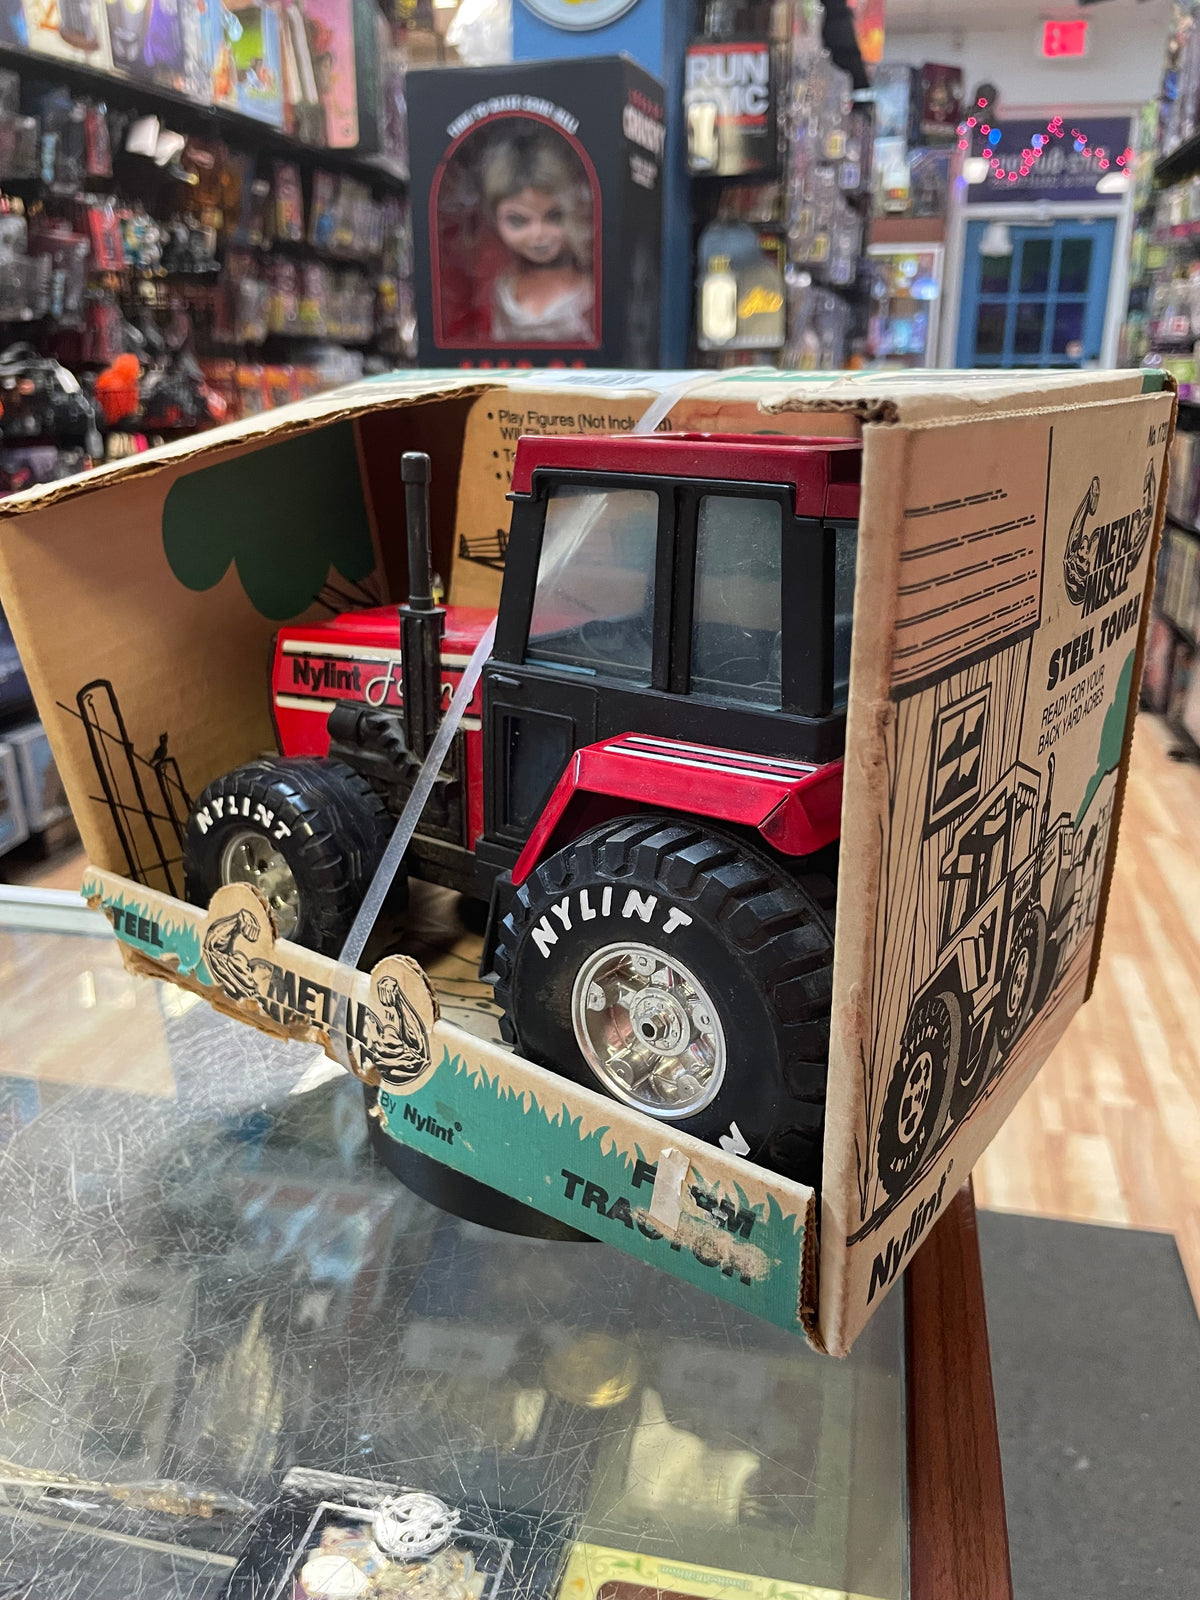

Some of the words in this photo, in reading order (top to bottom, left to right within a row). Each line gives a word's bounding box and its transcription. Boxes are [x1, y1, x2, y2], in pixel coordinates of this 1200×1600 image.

[685, 52, 770, 86] RUN
[499, 410, 524, 427] Play
[528, 411, 575, 429] Figures
[578, 414, 606, 431] (Not
[609, 416, 672, 432] Includ)
[1093, 509, 1141, 571] METAL
[1081, 550, 1138, 619] MUSCLE
[1047, 627, 1095, 691] STEEL
[1099, 592, 1141, 654] TOUGH
[293, 656, 361, 692] Nylint
[1041, 691, 1071, 730] READY
[1070, 679, 1086, 707] FOR
[1086, 664, 1105, 694] YOUR
[1038, 721, 1061, 756] BACK
[1062, 704, 1083, 736] YARD
[1081, 685, 1105, 718] ACRES
[196, 795, 292, 840] NYLINT
[111, 906, 164, 949] TEEL
[531, 886, 693, 958] NYLINT
[385, 1010, 395, 1022] TM
[381, 1091, 396, 1114] By
[631, 1158, 757, 1240] FRM
